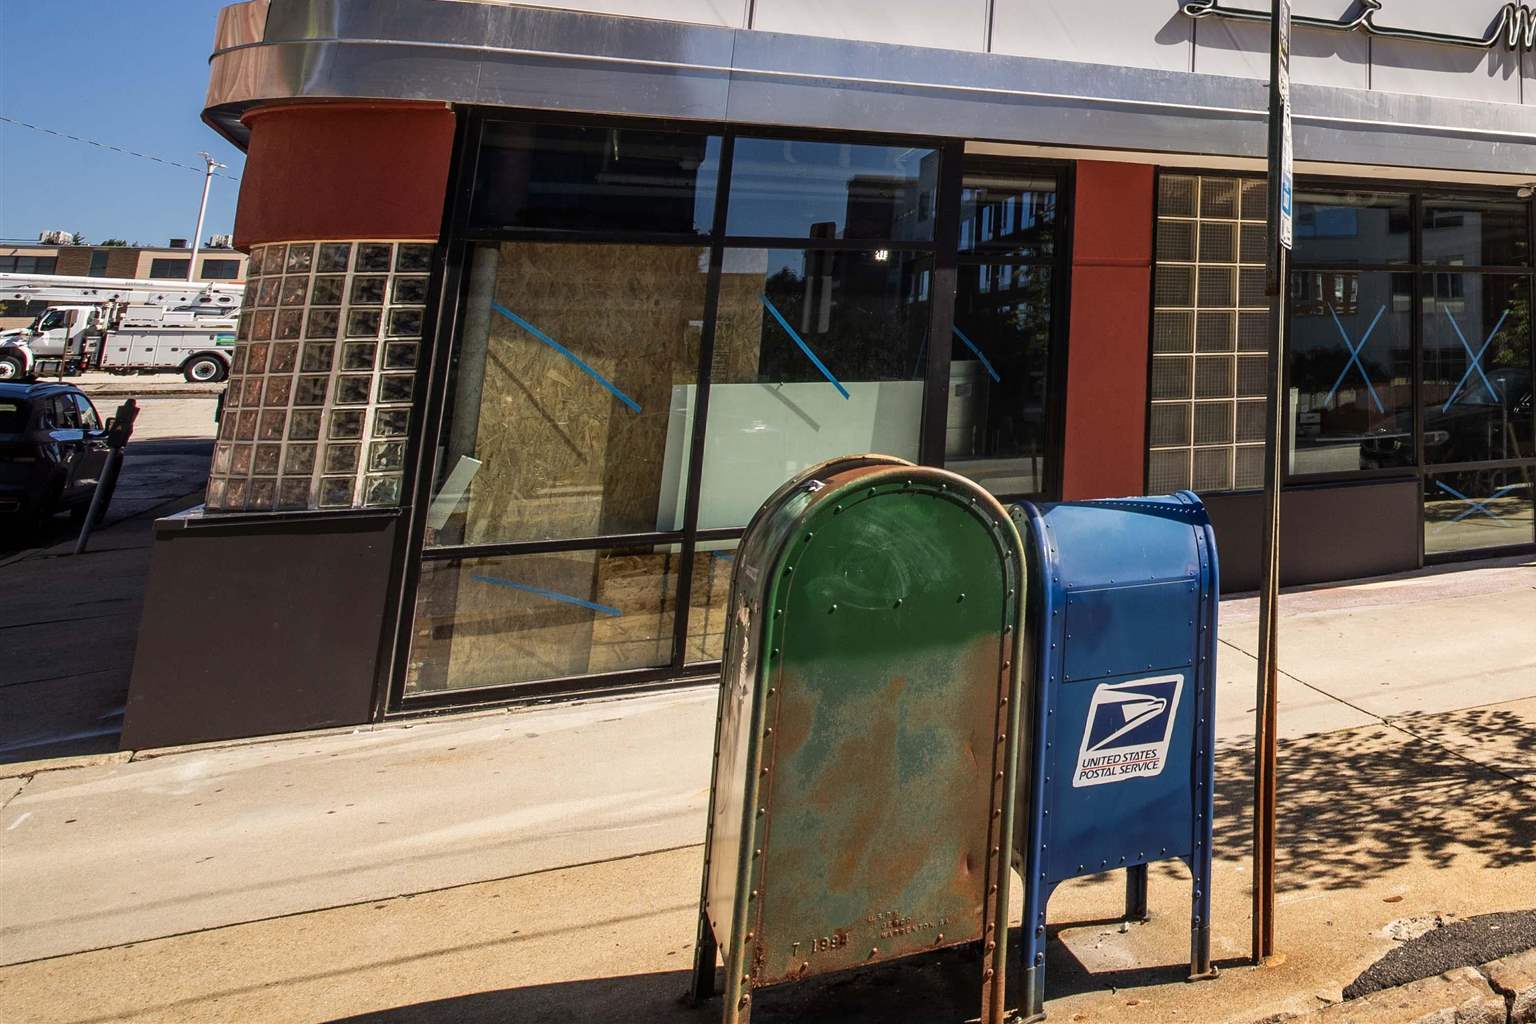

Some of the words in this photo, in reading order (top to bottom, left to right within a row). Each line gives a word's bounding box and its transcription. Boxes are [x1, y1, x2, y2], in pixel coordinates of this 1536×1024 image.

[1082, 754, 1122, 768] UNITED
[1122, 749, 1158, 762] STATES
[1079, 766, 1117, 781] POSTAL
[1119, 760, 1159, 775] SERVICE
